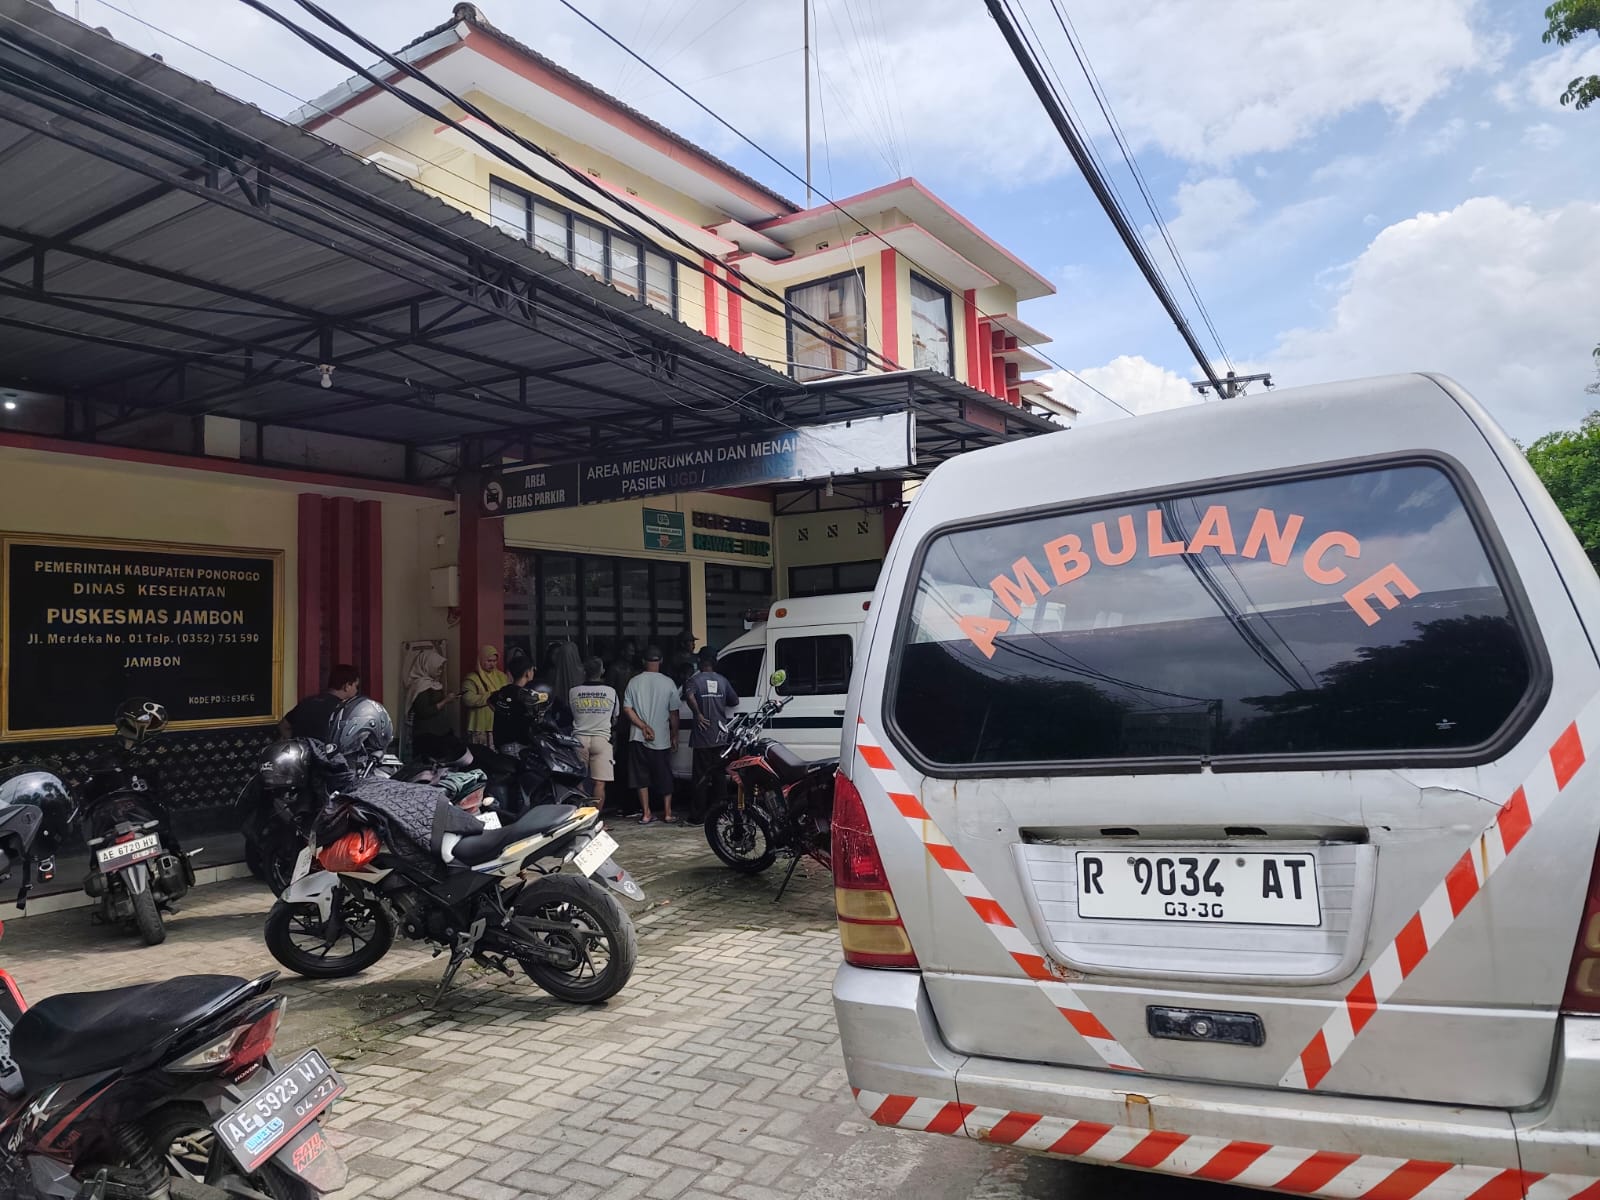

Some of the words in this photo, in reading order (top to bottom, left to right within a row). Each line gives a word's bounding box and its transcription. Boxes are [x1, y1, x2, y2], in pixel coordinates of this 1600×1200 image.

[587, 464, 620, 480] AREA
[622, 449, 713, 475] MENURUNKAN
[717, 445, 747, 461] DAN
[750, 438, 799, 457] MENAI
[525, 474, 546, 489] AREA
[622, 474, 666, 493] PASIEN
[507, 494, 533, 509] BEBAS
[534, 489, 565, 505] PARKIR
[34, 560, 121, 575] PEMERINTAH
[124, 564, 194, 579] KABUPATEN
[197, 568, 260, 581] PONOROGO
[73, 583, 125, 595] DINAS
[138, 584, 226, 598] KESEHATAN
[958, 504, 1421, 660] AMBULANCE
[47, 608, 169, 625] PUSKESMAS
[173, 610, 244, 625] JAMBON
[47, 633, 102, 644] Merdeka
[105, 634, 125, 644] No.
[128, 633, 143, 643] 01
[146, 633, 174, 645] Telp.
[177, 633, 215, 645] (0352)
[123, 656, 181, 668] JAMBON
[189, 695, 209, 705] KODE
[103, 850, 114, 861] AE
[118, 841, 141, 855] 6720
[1083, 857, 1104, 895] R
[1133, 857, 1225, 897] 9034
[1262, 859, 1306, 900] AT
[229, 1112, 256, 1142] AE
[255, 1078, 299, 1117] 5923
[298, 1057, 324, 1082] WI
